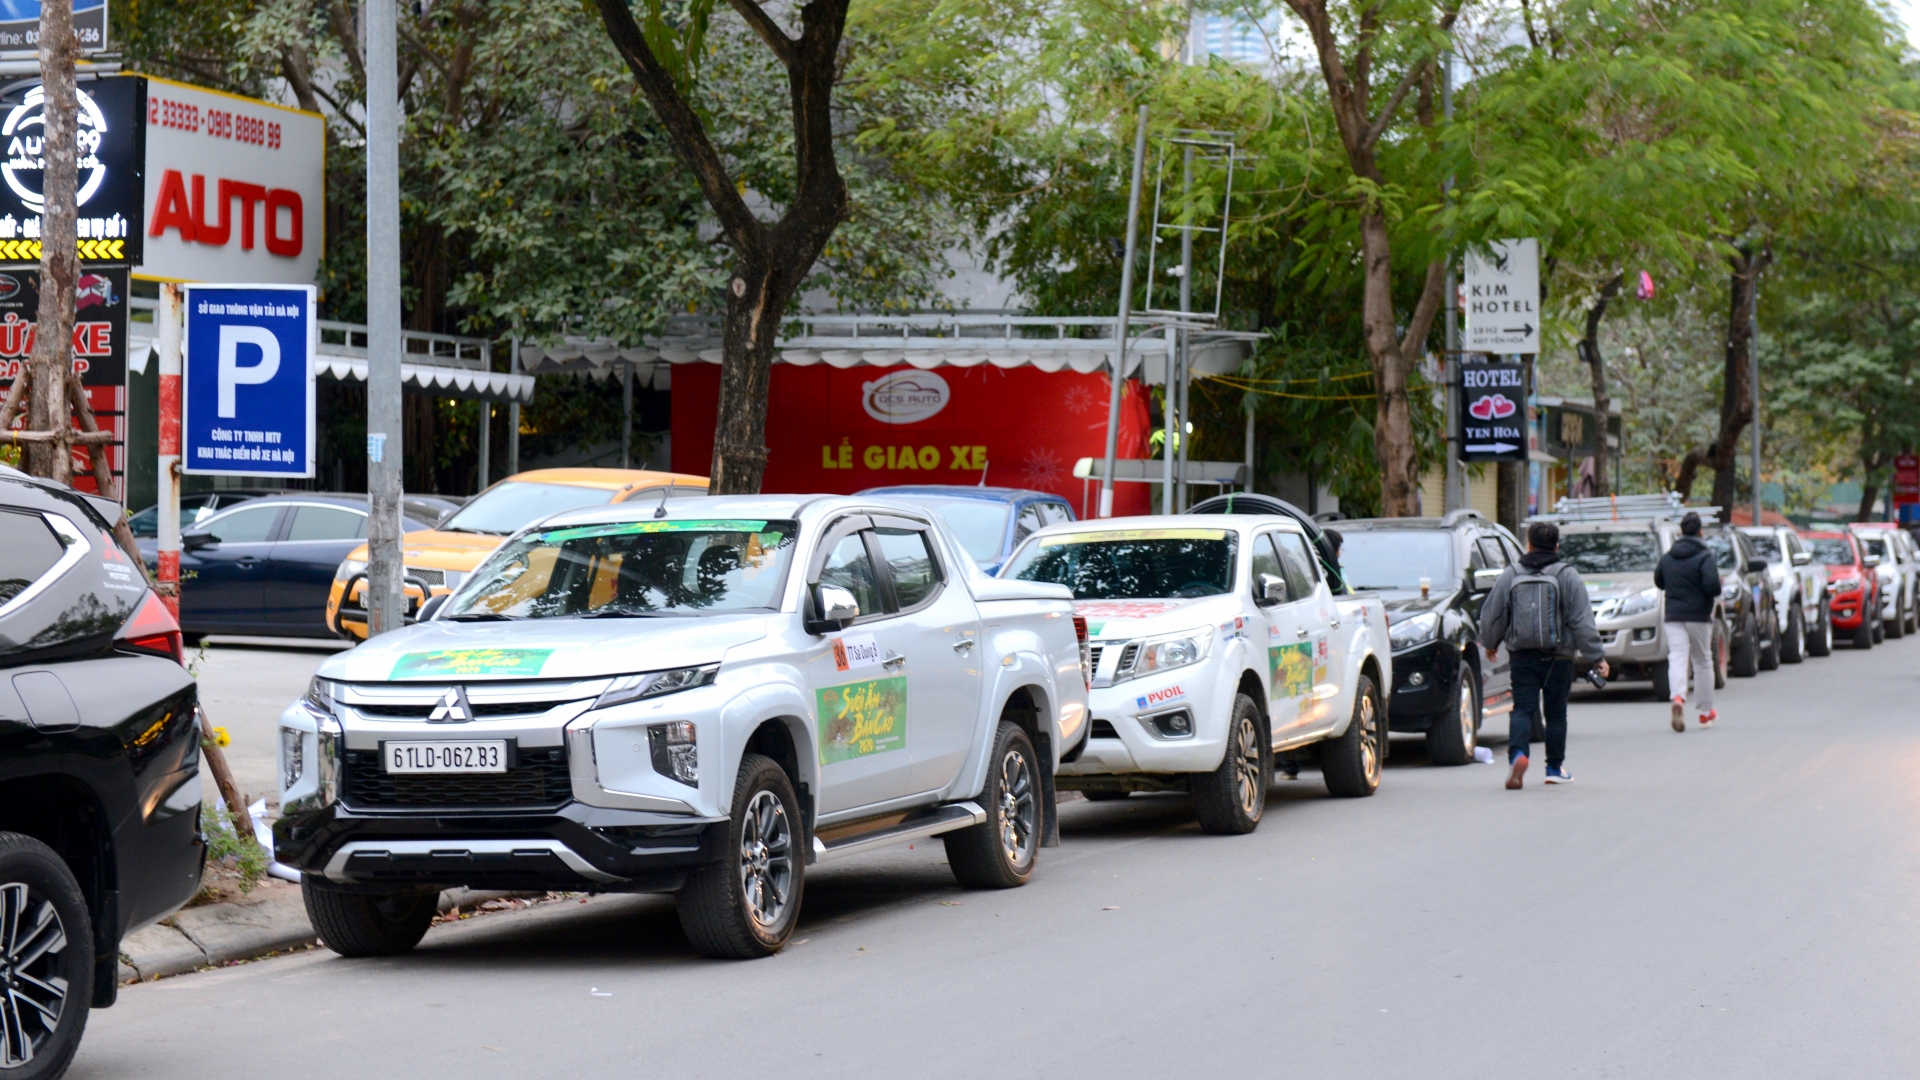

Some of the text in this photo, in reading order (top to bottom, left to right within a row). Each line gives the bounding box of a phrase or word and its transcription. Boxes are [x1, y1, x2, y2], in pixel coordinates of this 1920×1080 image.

[162, 99, 199, 132] 33333
[208, 108, 232, 139] 0915
[236, 114, 265, 146] 8888
[268, 121, 281, 149] 99
[149, 168, 304, 257] AUTO
[1472, 284, 1508, 296] KIM
[209, 303, 225, 315] GIAO
[226, 302, 248, 316] THÔNG
[276, 304, 286, 317] HÀ
[287, 304, 300, 319] NỘI
[1472, 300, 1533, 313] HOTEL
[218, 325, 281, 418] P
[1464, 370, 1522, 387] HOTEL
[908, 394, 941, 404] AUTO
[211, 427, 282, 443] CÔNG TY TNHH MTV
[1466, 427, 1520, 439] YEN HOA
[197, 446, 214, 459] KHAI
[214, 446, 232, 459] THÁC
[261, 449, 271, 461] XE
[272, 448, 281, 461] HÀ
[282, 448, 295, 465] NỘI
[863, 445, 941, 470] GIAO
[950, 446, 987, 470] XE
[1148, 685, 1184, 704] PVOIL
[394, 746, 498, 768] 61LD-062.83
